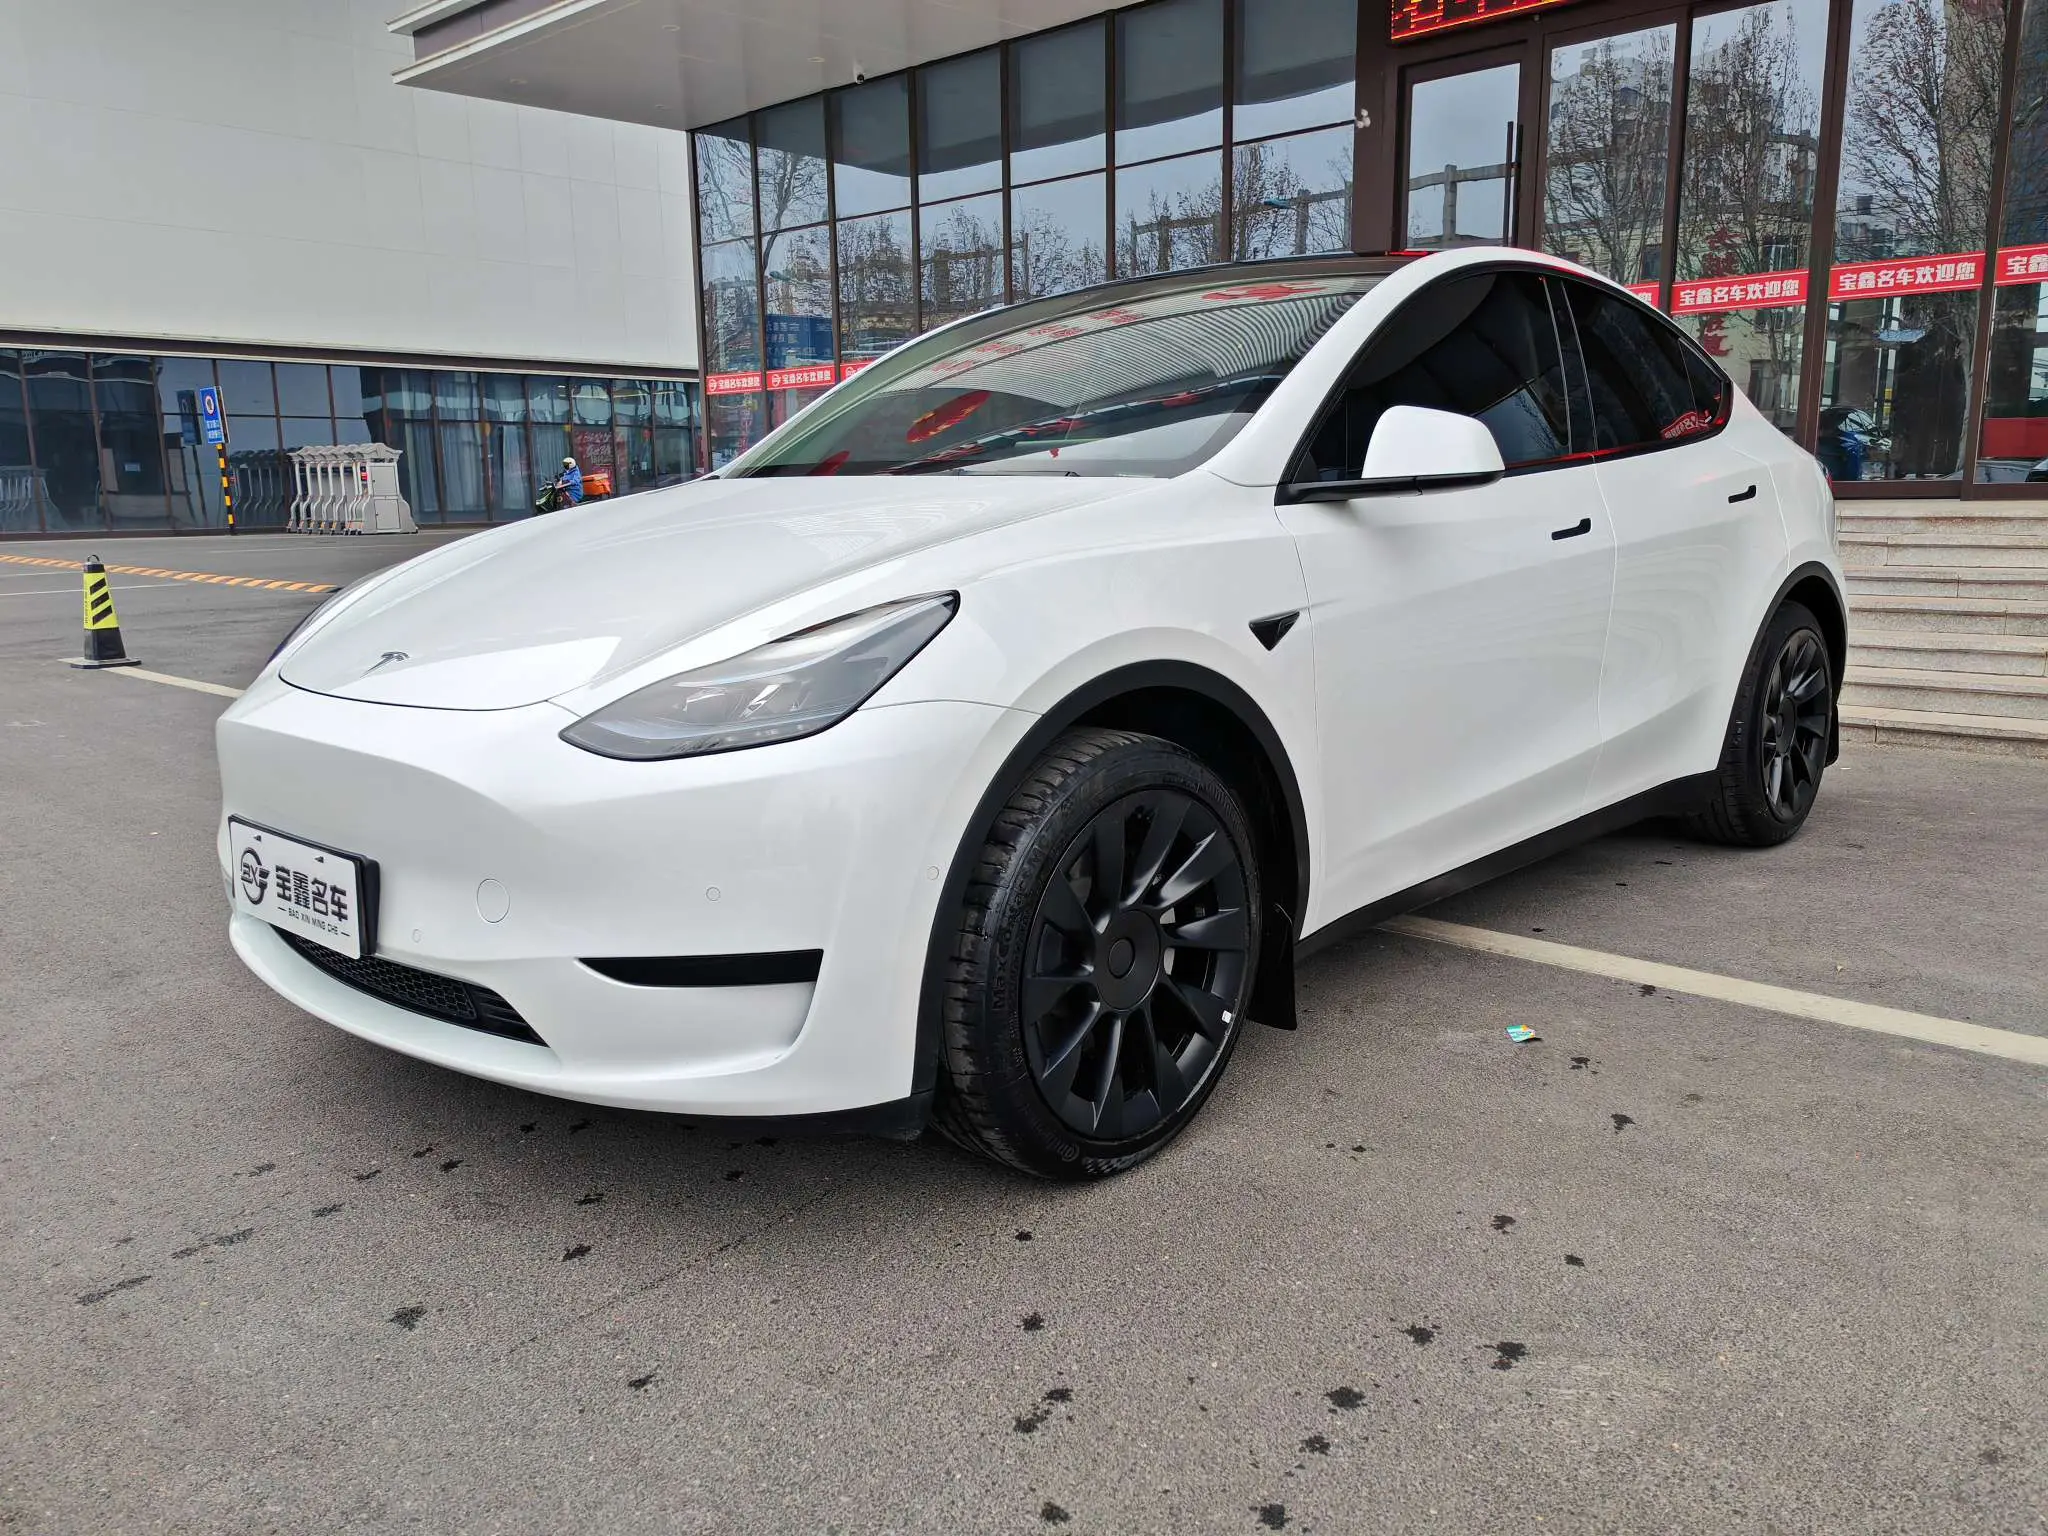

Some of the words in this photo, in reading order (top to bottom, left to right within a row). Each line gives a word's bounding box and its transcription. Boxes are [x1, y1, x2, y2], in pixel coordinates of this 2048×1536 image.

[1838, 262, 1976, 292] 宝鑫名车欢迎您
[1679, 279, 1800, 307] 宝鑫名车欢迎您
[275, 865, 348, 922] 宝鑫名车
